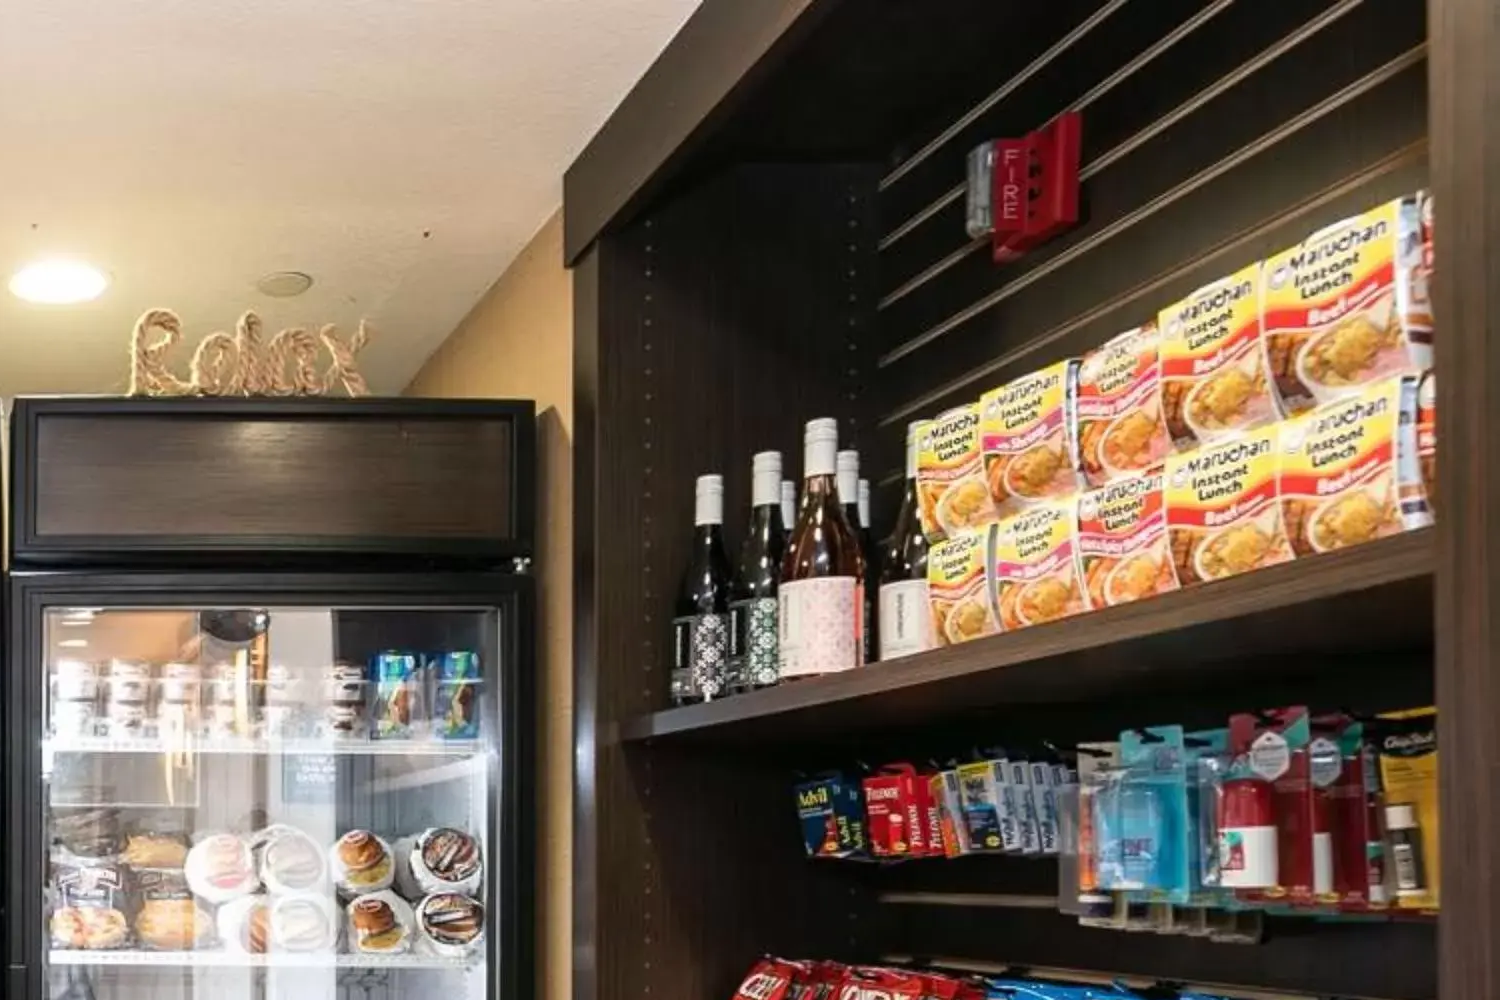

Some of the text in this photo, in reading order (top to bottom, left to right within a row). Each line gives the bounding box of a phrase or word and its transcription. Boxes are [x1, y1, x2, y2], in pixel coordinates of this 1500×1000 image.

[1003, 148, 1020, 220] FIRE
[1289, 219, 1387, 269] Maruchan
[1294, 251, 1361, 288] Instant
[1300, 272, 1354, 300] Lunch
[1178, 280, 1252, 322] Maruchan
[1188, 325, 1230, 351] Lunch
[997, 374, 1060, 406] Maruchan
[930, 413, 979, 439] Marucha
[1005, 410, 1039, 430] Lunch
[1187, 438, 1271, 474] Maruchan
[1312, 444, 1358, 468] Lunch
[1198, 480, 1243, 502] Lunch
[1013, 509, 1062, 532] Marucha
[1104, 511, 1140, 532] Lunch
